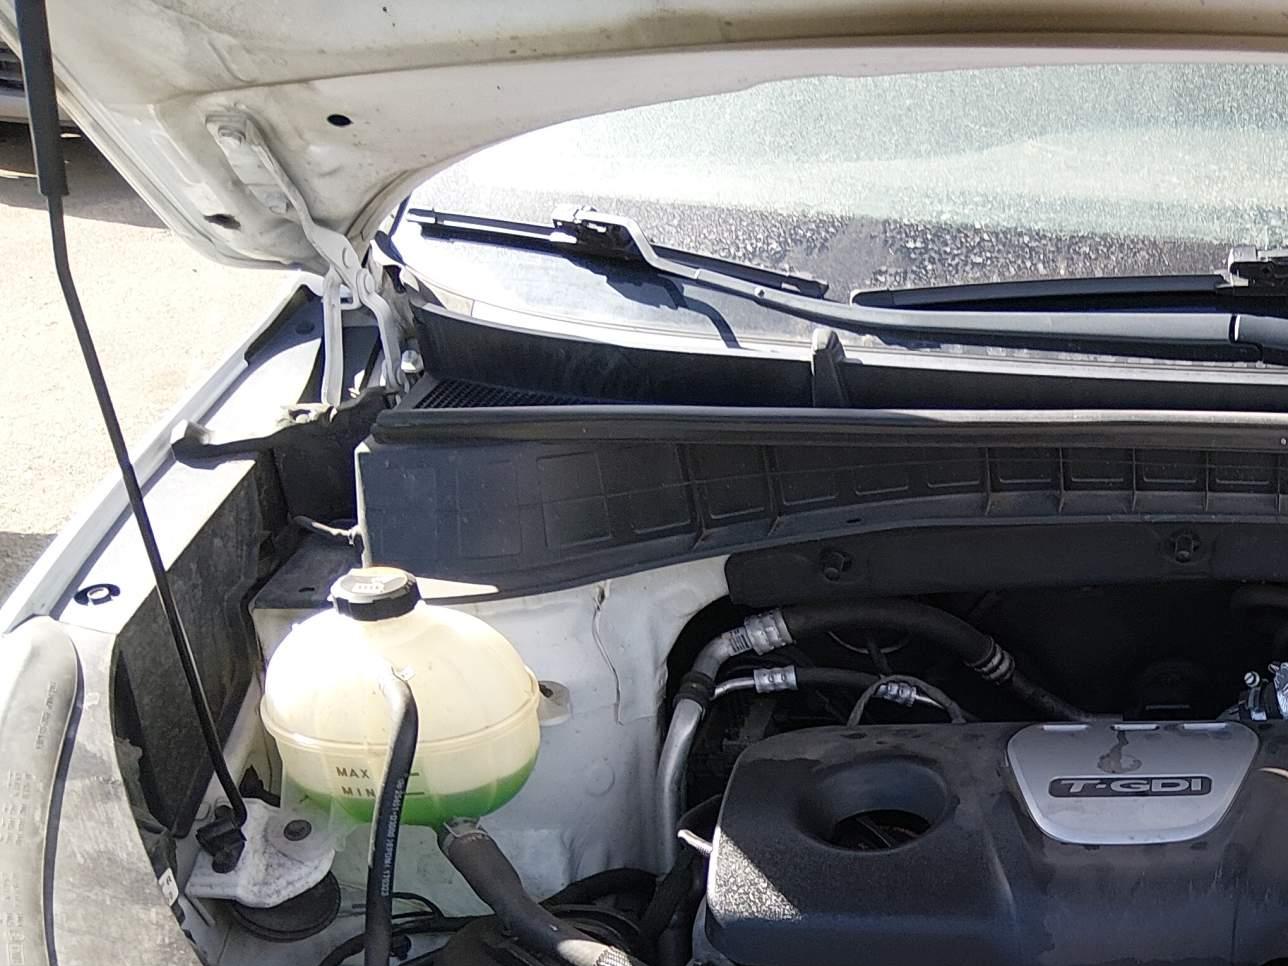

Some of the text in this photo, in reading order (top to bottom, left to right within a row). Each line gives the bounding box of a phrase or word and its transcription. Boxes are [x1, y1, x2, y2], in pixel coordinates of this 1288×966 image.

[336, 766, 371, 780] MAX
[341, 786, 376, 798] MIN
[1060, 778, 1202, 793] T-GDI
